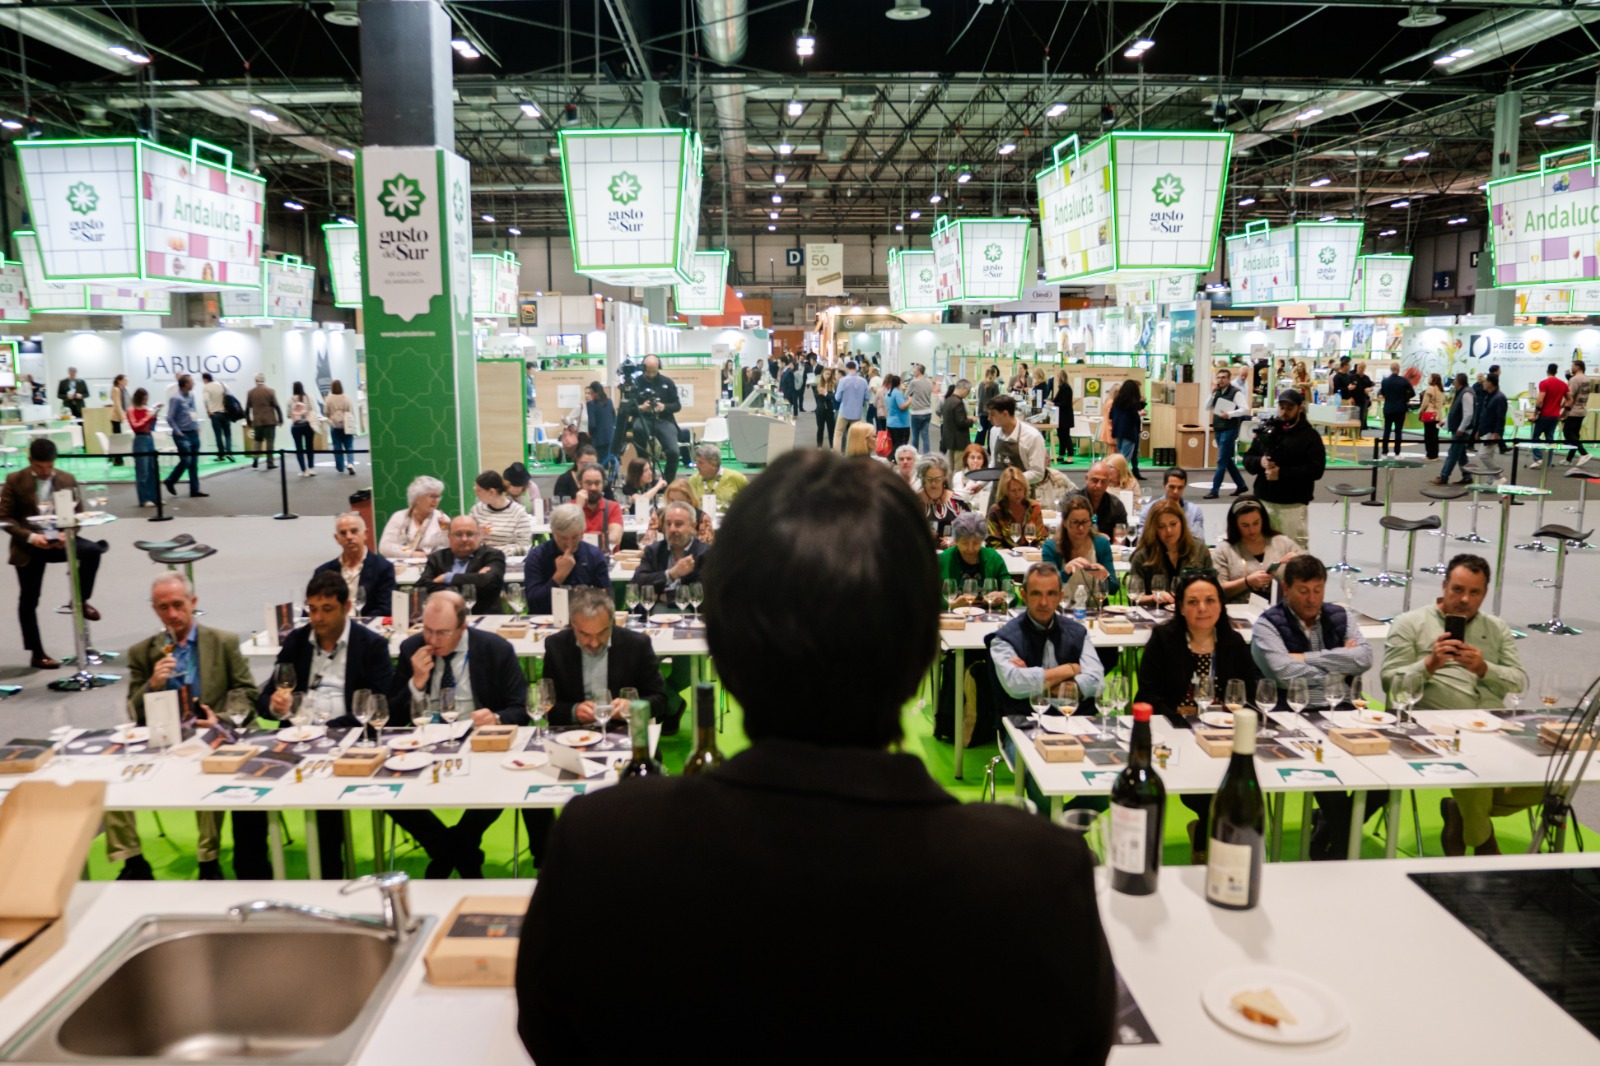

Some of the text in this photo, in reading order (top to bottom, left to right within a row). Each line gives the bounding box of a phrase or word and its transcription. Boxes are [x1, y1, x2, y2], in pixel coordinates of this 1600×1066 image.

[173, 194, 240, 232] Andalucía
[1055, 185, 1094, 227] Andalucía
[608, 208, 643, 224] gusto
[1150, 209, 1184, 225] gusto
[69, 219, 104, 234] gusto
[620, 220, 644, 232] Sur
[1160, 221, 1184, 233] Sur
[82, 230, 106, 242] Sur
[379, 227, 429, 250] gusto
[396, 243, 430, 261] Sur
[789, 250, 801, 265] D
[811, 254, 830, 266] 50
[1443, 276, 1450, 287] 3
[1493, 342, 1526, 350] PRIEGO
[146, 355, 242, 379] JABUGO
